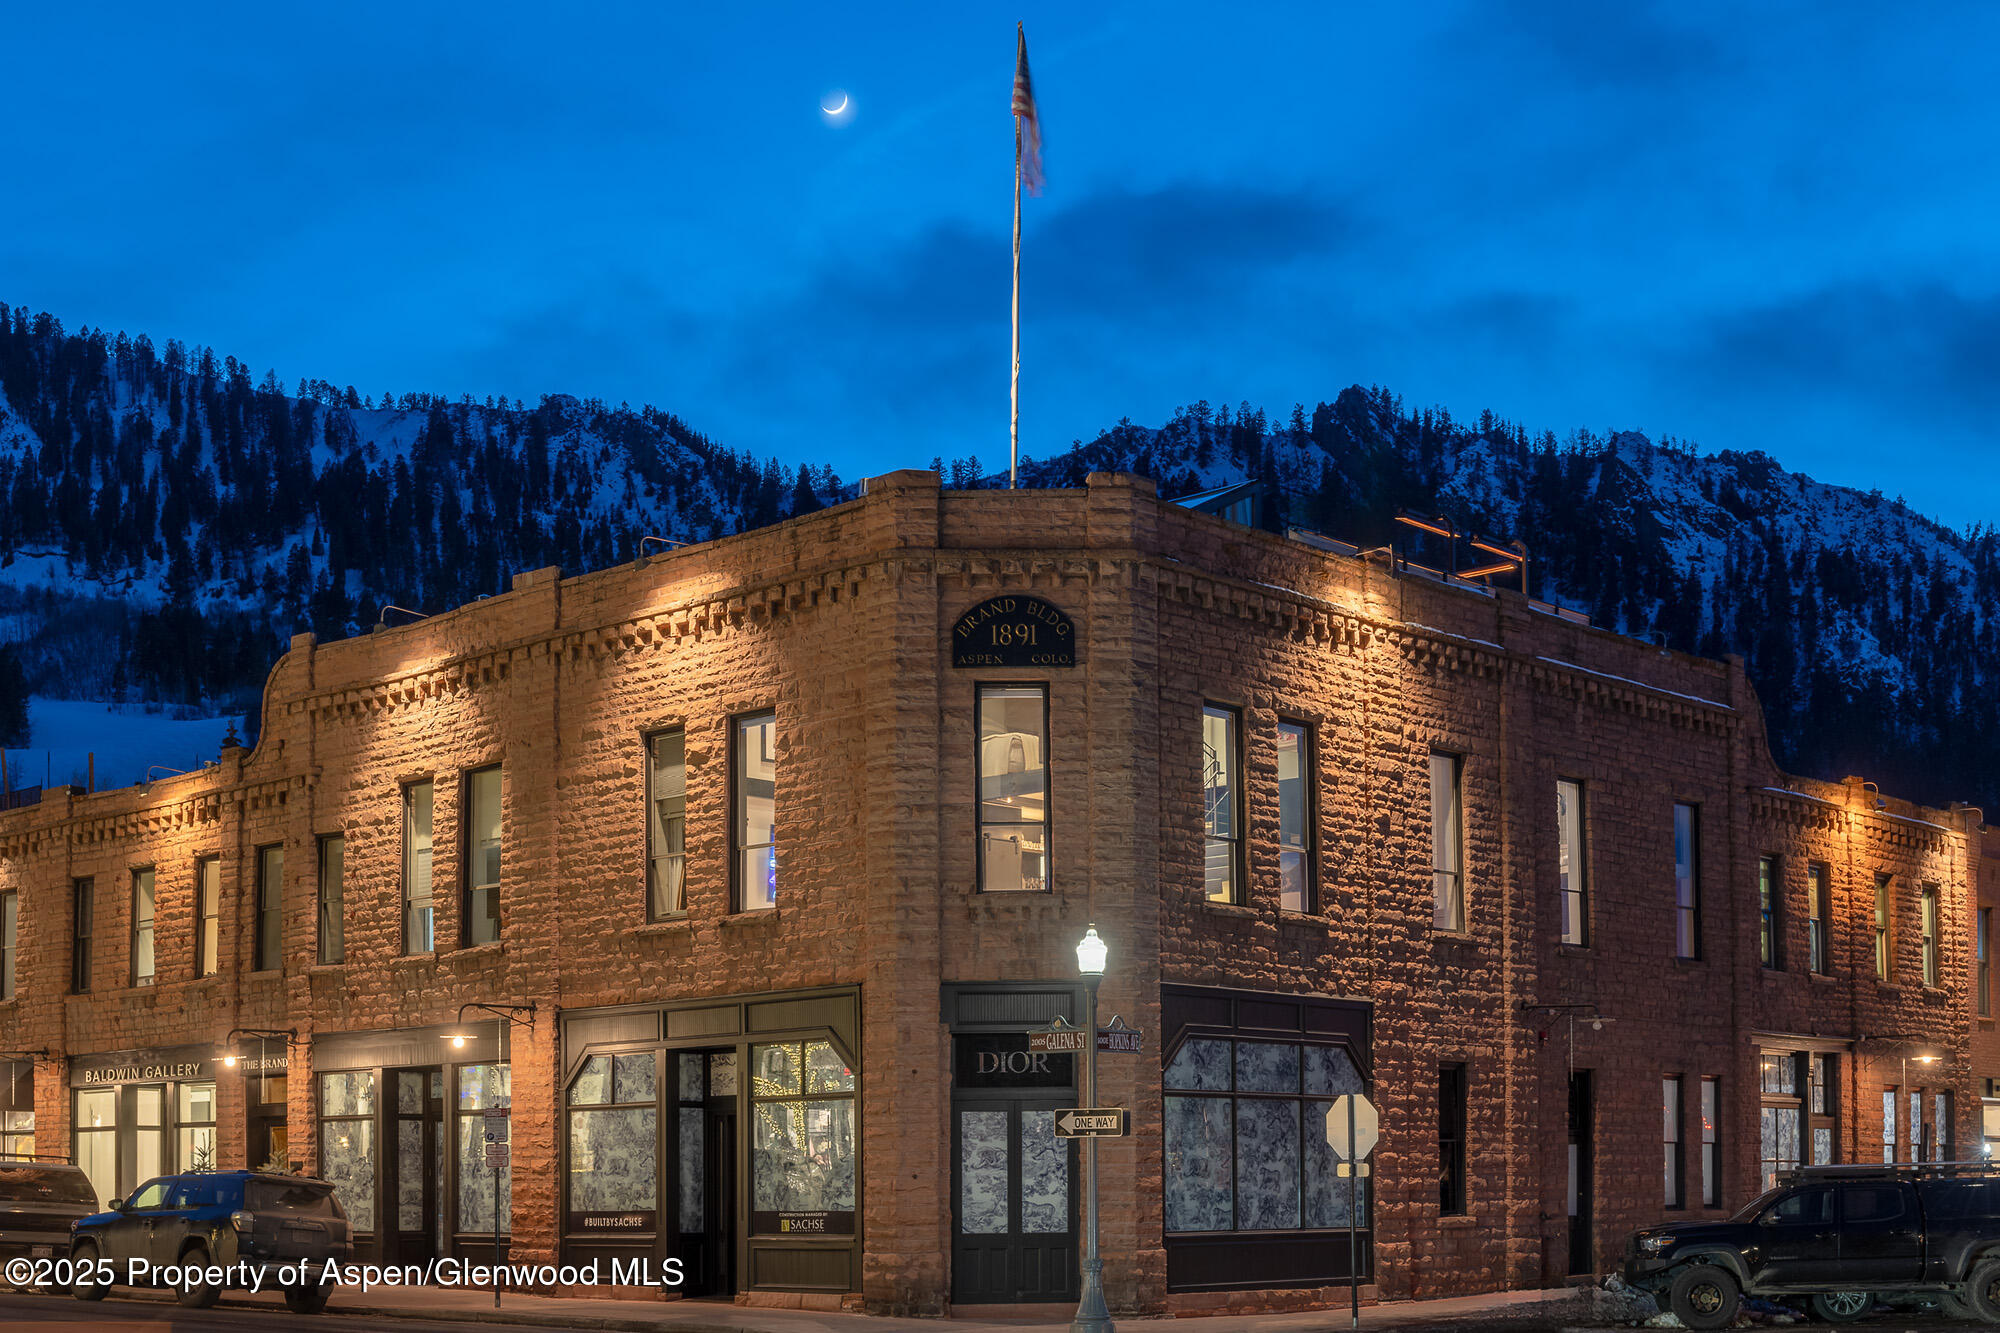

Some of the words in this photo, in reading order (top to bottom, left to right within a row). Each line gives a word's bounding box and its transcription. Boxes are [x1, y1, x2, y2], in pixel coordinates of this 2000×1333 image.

[957, 599, 1016, 638] BRAND
[991, 623, 1038, 646] 1891
[958, 654, 1004, 664] ASPEN
[1046, 1033, 1075, 1050] GALENA
[1077, 1032, 1086, 1049] ST
[241, 1060, 259, 1070] THE
[976, 1051, 1051, 1074] DIOR
[85, 1065, 140, 1083] BALDWIN
[145, 1063, 200, 1078] GALLERY
[1074, 1117, 1093, 1128] ONE
[1095, 1117, 1115, 1128] WAY
[584, 1217, 643, 1227] #BUILTBYSACHSE
[790, 1219, 825, 1230] SACHSE
